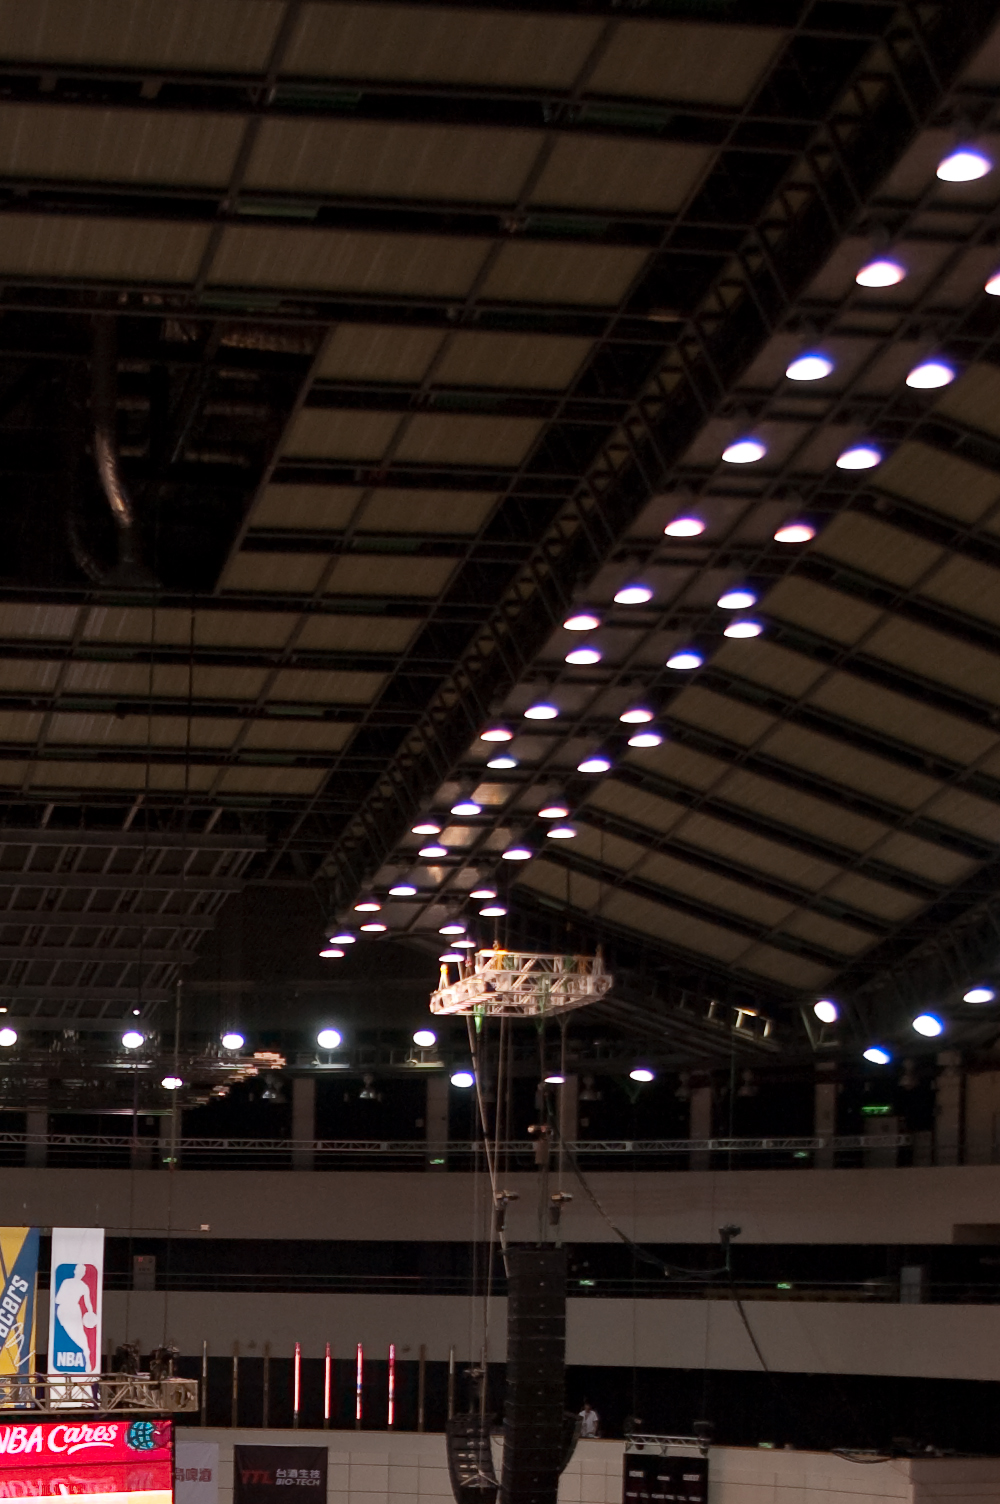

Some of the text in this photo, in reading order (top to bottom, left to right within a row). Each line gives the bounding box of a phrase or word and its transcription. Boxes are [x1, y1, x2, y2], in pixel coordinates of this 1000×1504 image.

[56, 1351, 84, 1367] NBA
[48, 1424, 119, 1453] Cares
[275, 1478, 321, 1486] BIO-TECH
